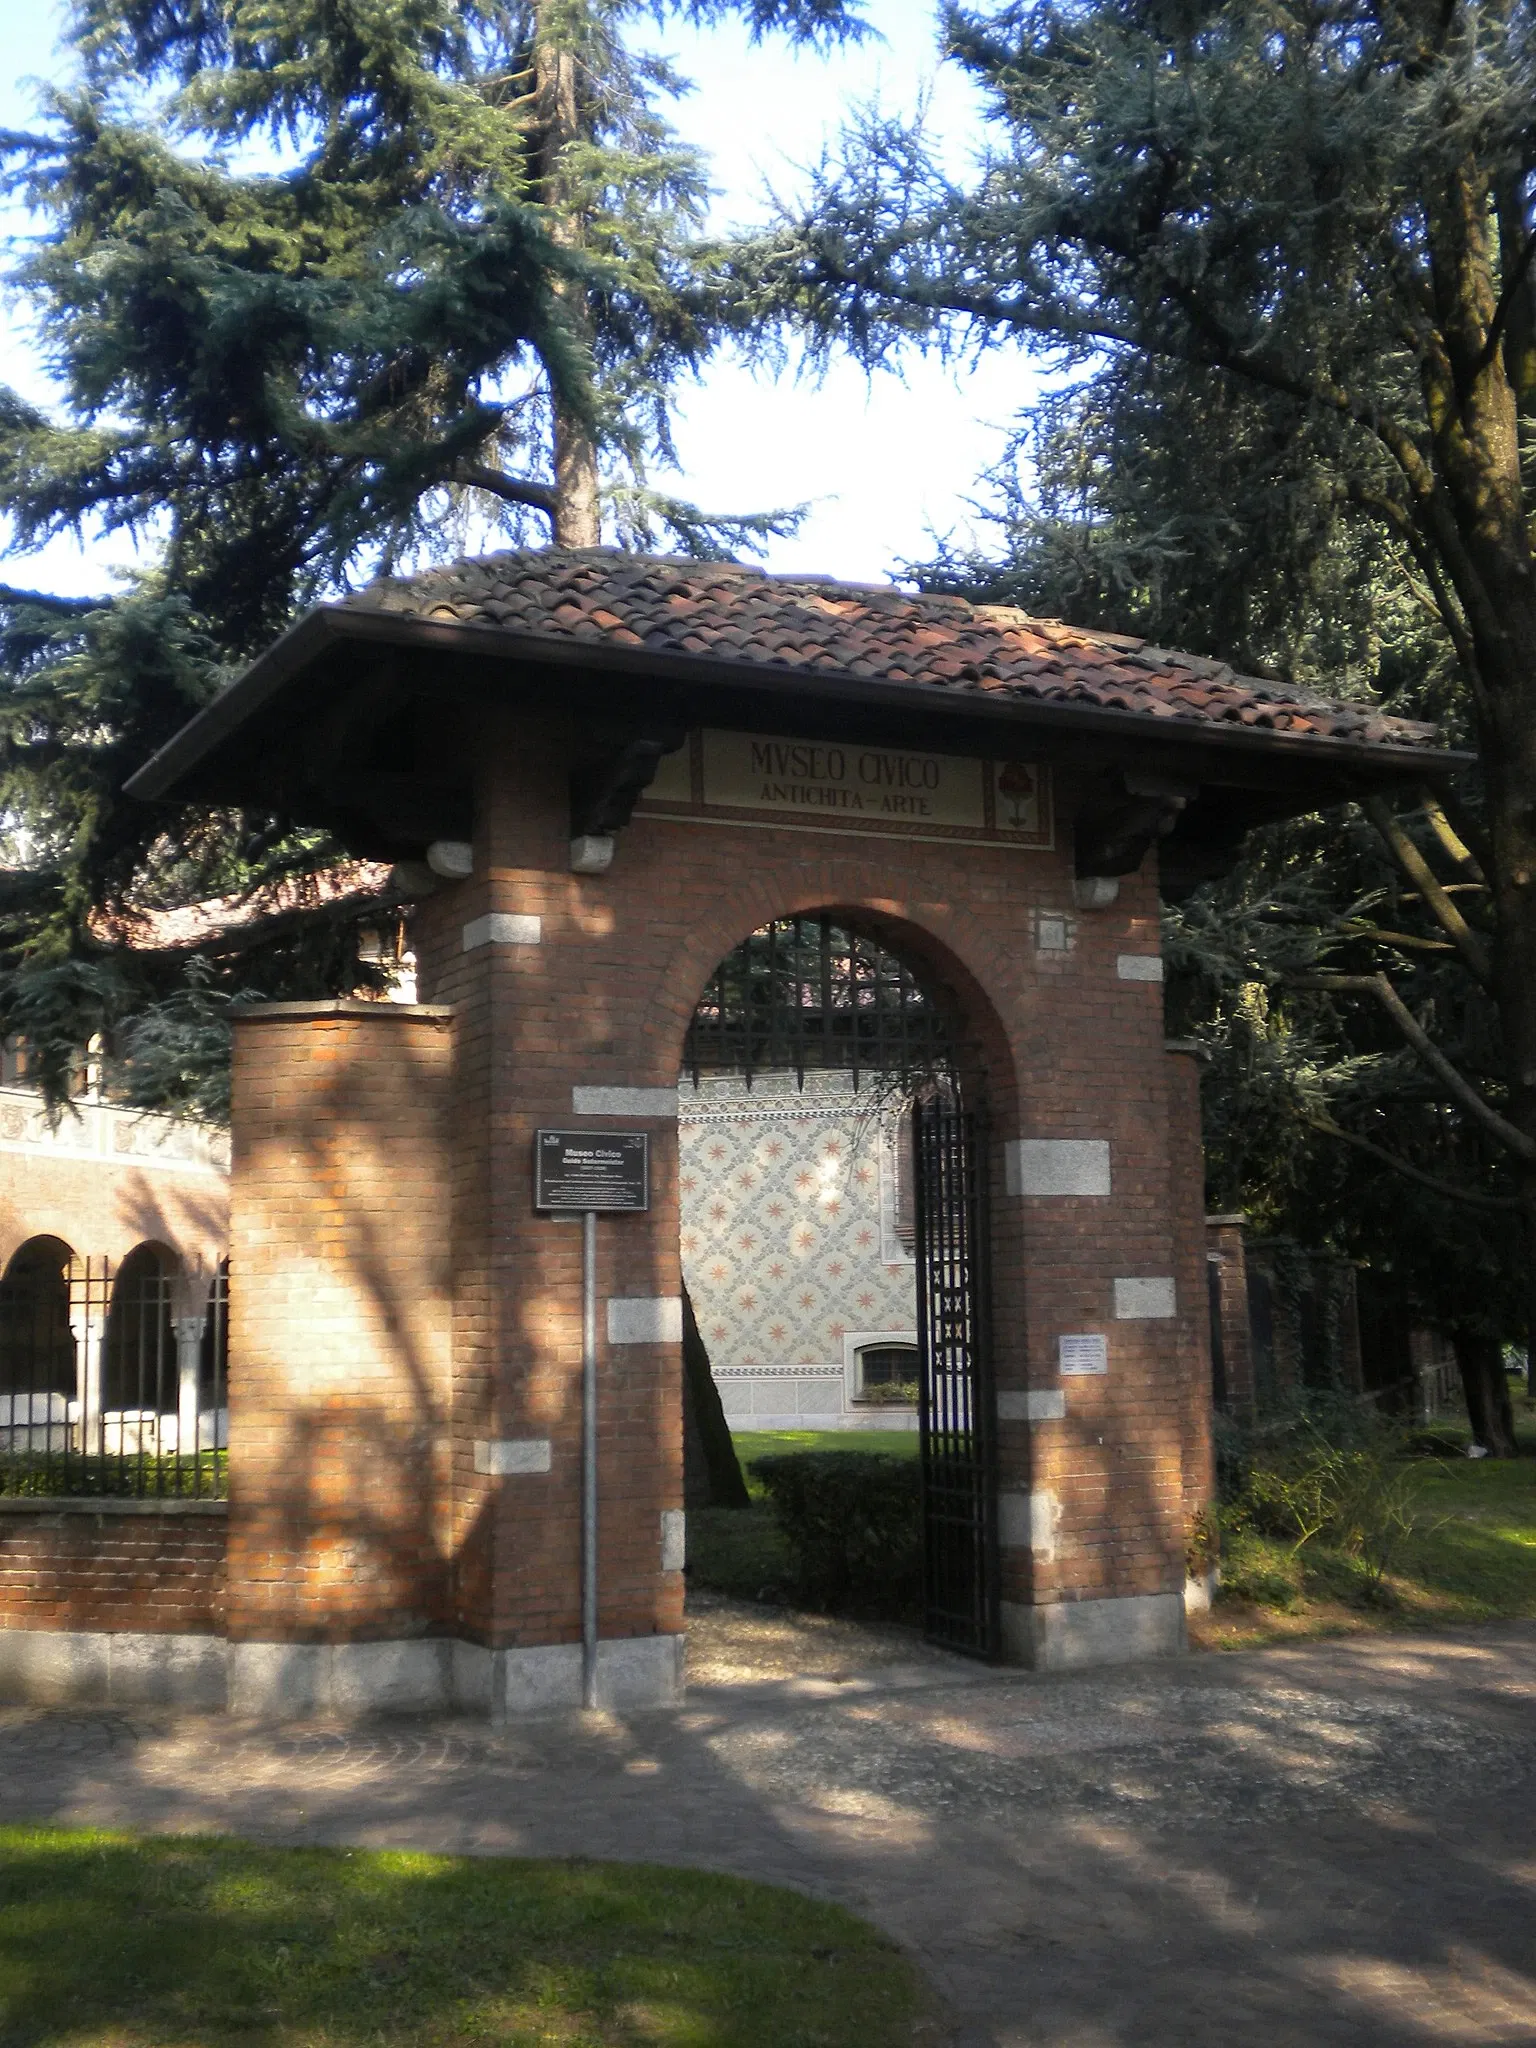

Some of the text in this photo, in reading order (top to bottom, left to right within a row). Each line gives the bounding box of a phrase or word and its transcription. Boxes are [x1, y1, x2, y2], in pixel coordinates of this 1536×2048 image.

[751, 741, 940, 790] MVSEO CIVICO
[880, 795, 932, 815] ARTE
[565, 1149, 622, 1158] Museo Civico
